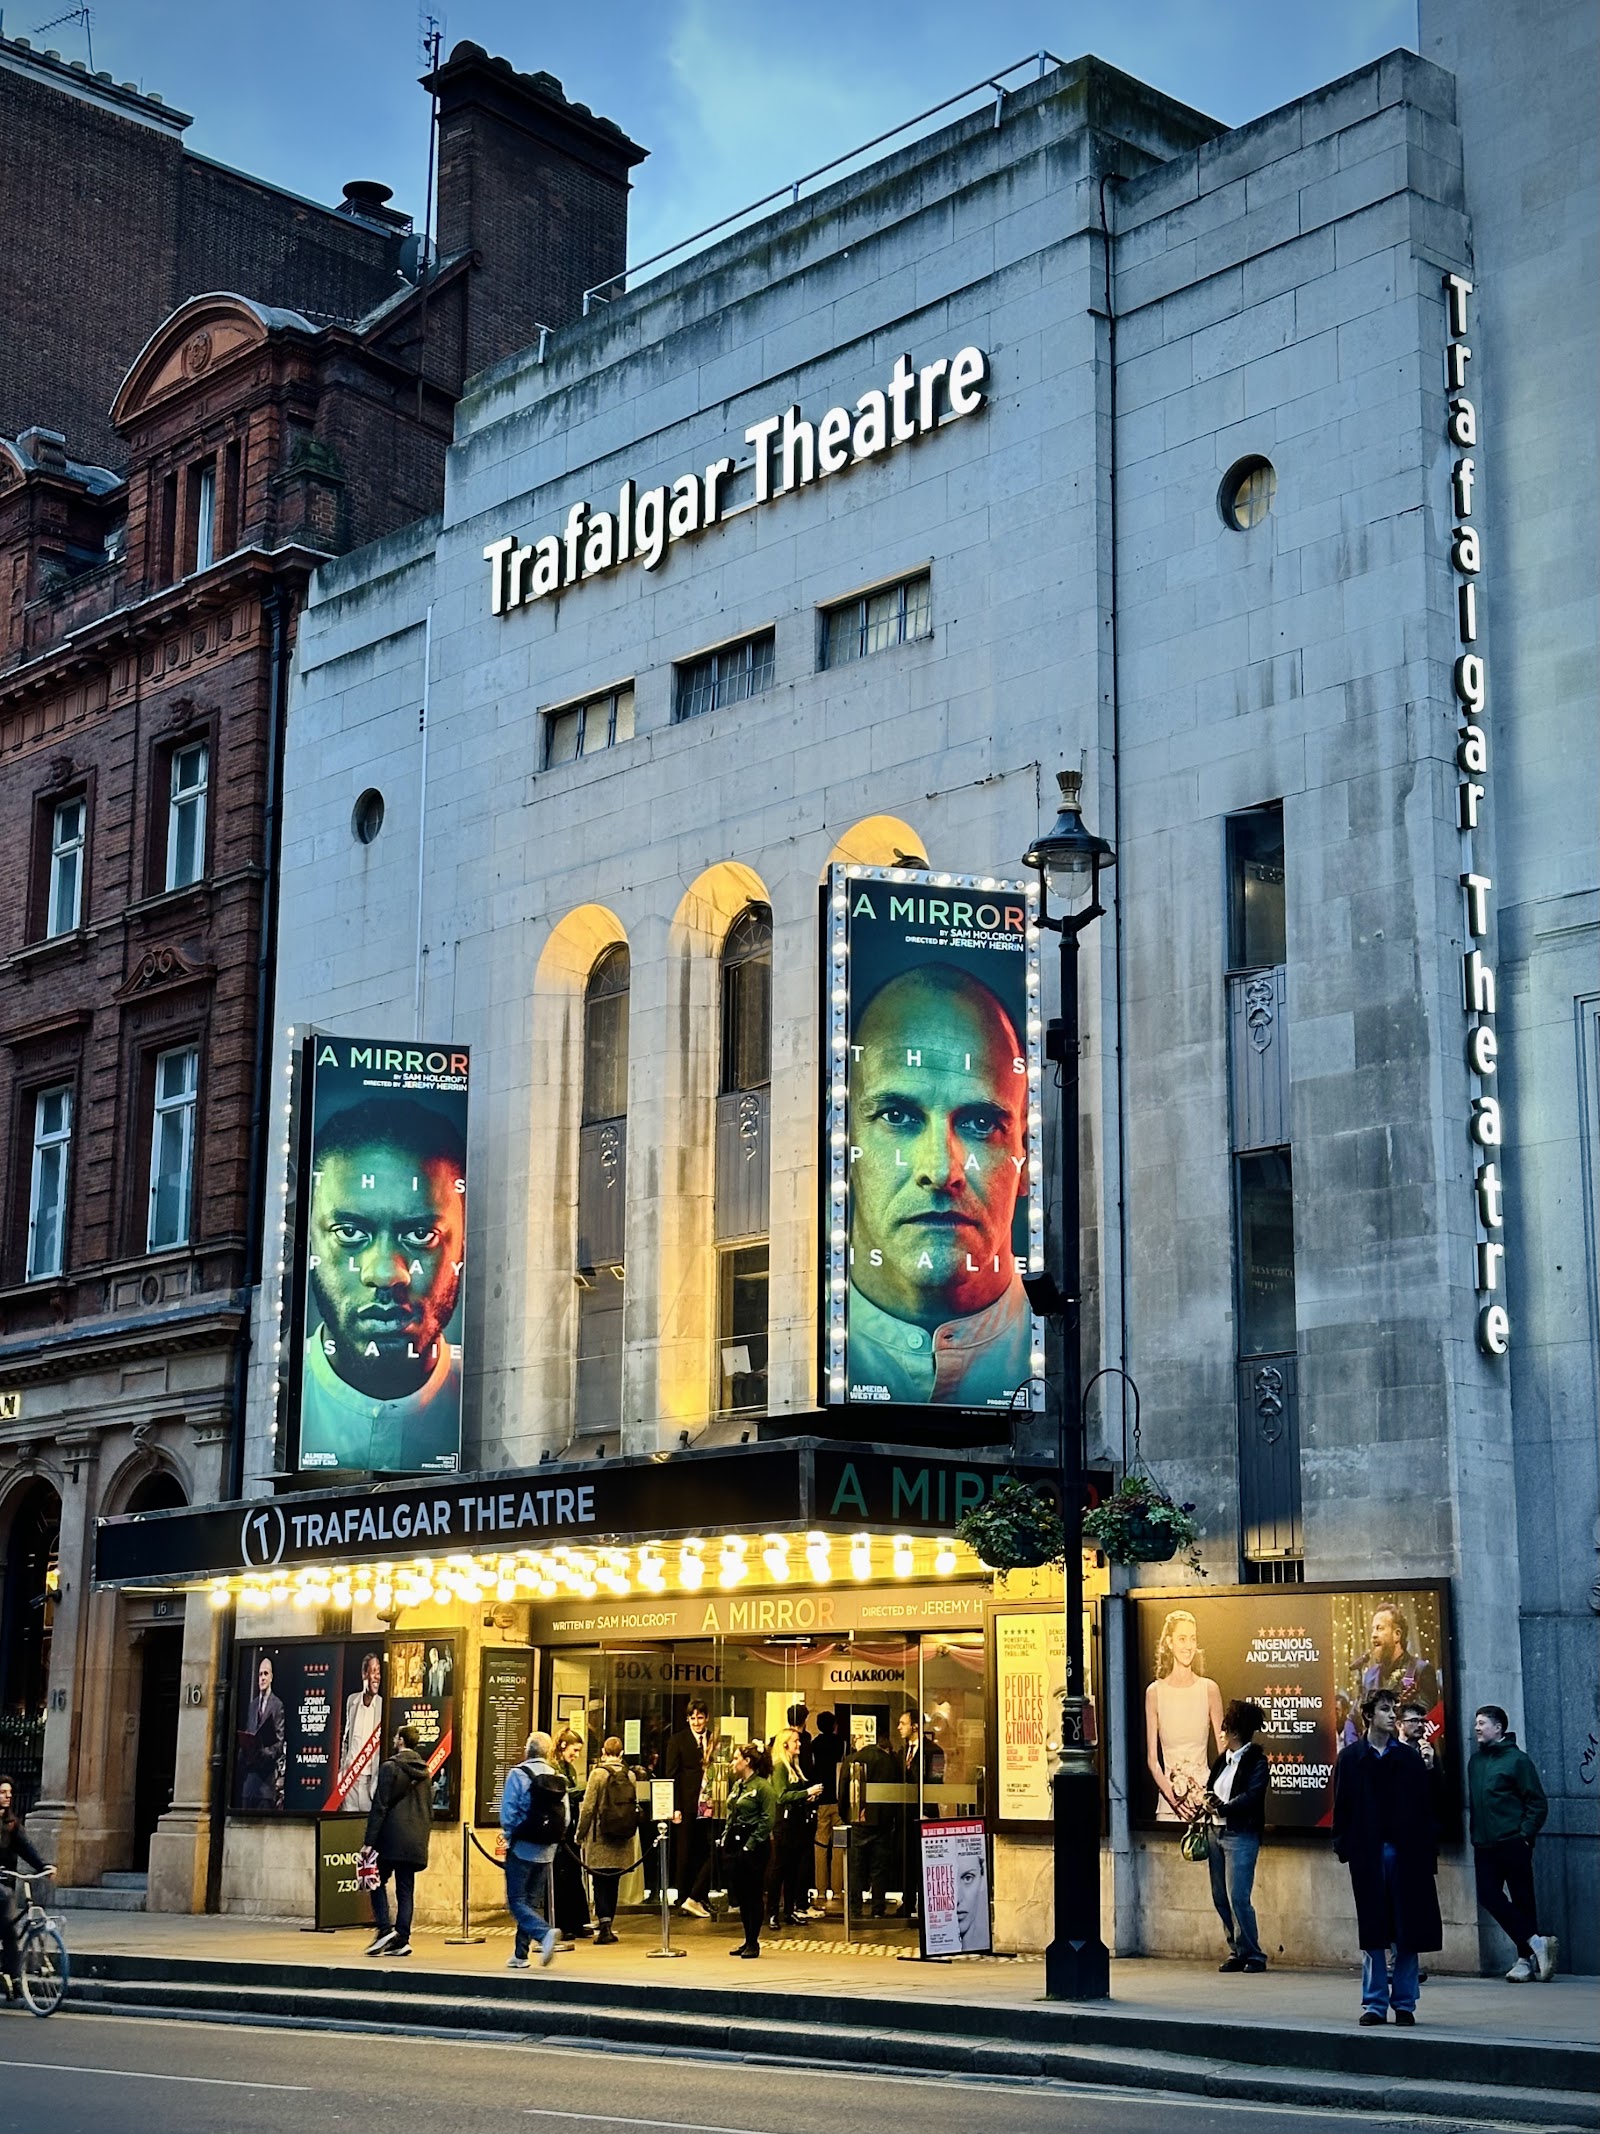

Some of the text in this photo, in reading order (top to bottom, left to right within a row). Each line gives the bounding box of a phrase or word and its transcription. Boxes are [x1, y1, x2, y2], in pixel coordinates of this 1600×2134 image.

[483, 345, 989, 617] Trafalgar Theatre
[1442, 273, 1509, 1355] Trafalgar Theatre
[852, 893, 1024, 932] A MIRROR
[905, 935, 938, 945] DIRECTED
[950, 938, 987, 949] JEREMY
[989, 940, 1024, 952] HERRIN
[950, 928, 971, 939] SAM
[973, 930, 1024, 943] HOLCROFT
[317, 1045, 468, 1075] A MIRROR
[402, 1073, 421, 1081] SAM
[422, 1074, 468, 1084] HOLCROFT
[402, 1081, 435, 1090] JEREMY
[436, 1082, 468, 1092] HERRIN
[917, 1250, 934, 1270] A
[364, 1340, 380, 1358] A
[852, 1385, 889, 1393] ALMEIDA
[830, 1462, 869, 1517] A
[291, 1500, 452, 1549] TRAFALGAR
[459, 1485, 596, 1533] THEATRE
[157, 1601, 167, 1615] 16
[701, 1597, 835, 1632] A MIRROR
[862, 1605, 904, 1617] DIRECTED
[906, 1604, 918, 1616] BY
[921, 1600, 970, 1616] JEREMY
[552, 1612, 678, 1631] WRITTEN BY SAM HOLCROFT
[1251, 1638, 1313, 1650] 'INGENIOUS
[1245, 1650, 1320, 1663] AND PLAYFUL'
[488, 1675, 527, 1684] A MIRROR
[615, 1660, 726, 1683] BOX OFFICE
[830, 1668, 905, 1682] CLOAKROOM
[184, 1682, 202, 1705] 16
[1004, 1675, 1044, 1698] PEOPLE
[51, 1688, 66, 1712] 16
[1273, 1696, 1323, 1709] NOTHING
[1005, 1698, 1043, 1721] PLACES
[1271, 1709, 1298, 1720] ELSE
[1258, 1721, 1292, 1733] OU'LL
[338, 1772, 354, 1796] MUST
[353, 1757, 366, 1773] END
[1268, 1764, 1334, 1777] AORDINARY
[1270, 1776, 1328, 1789] MESMERIC'
[926, 1865, 954, 1882] PEOPLE
[927, 1880, 954, 1897] PLACES
